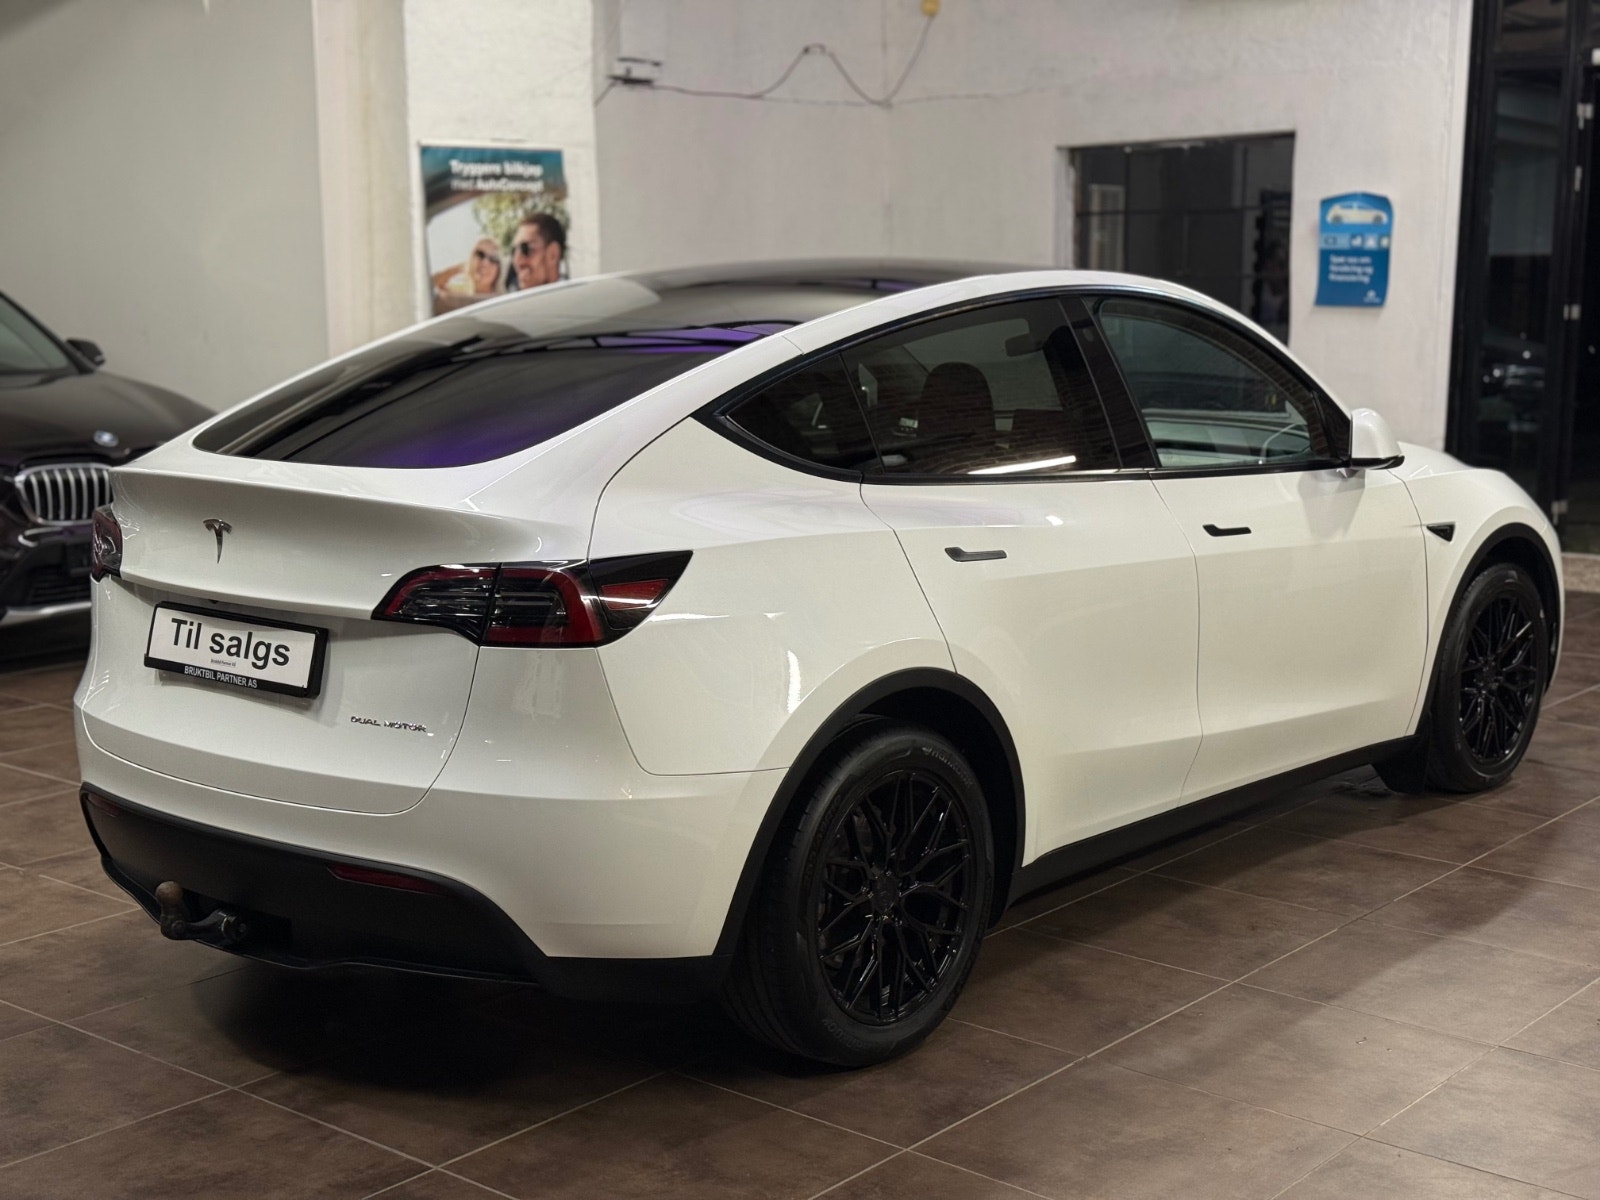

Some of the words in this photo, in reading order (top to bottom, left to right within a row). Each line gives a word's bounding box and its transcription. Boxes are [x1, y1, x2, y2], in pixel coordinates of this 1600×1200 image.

[171, 617, 202, 650] Til
[209, 631, 290, 670] salgs
[184, 665, 215, 680] BRUKTBIL
[216, 672, 247, 686] PARTNER
[247, 679, 258, 689] AS
[350, 716, 381, 726] DUAL
[383, 720, 427, 732] MOTOR
